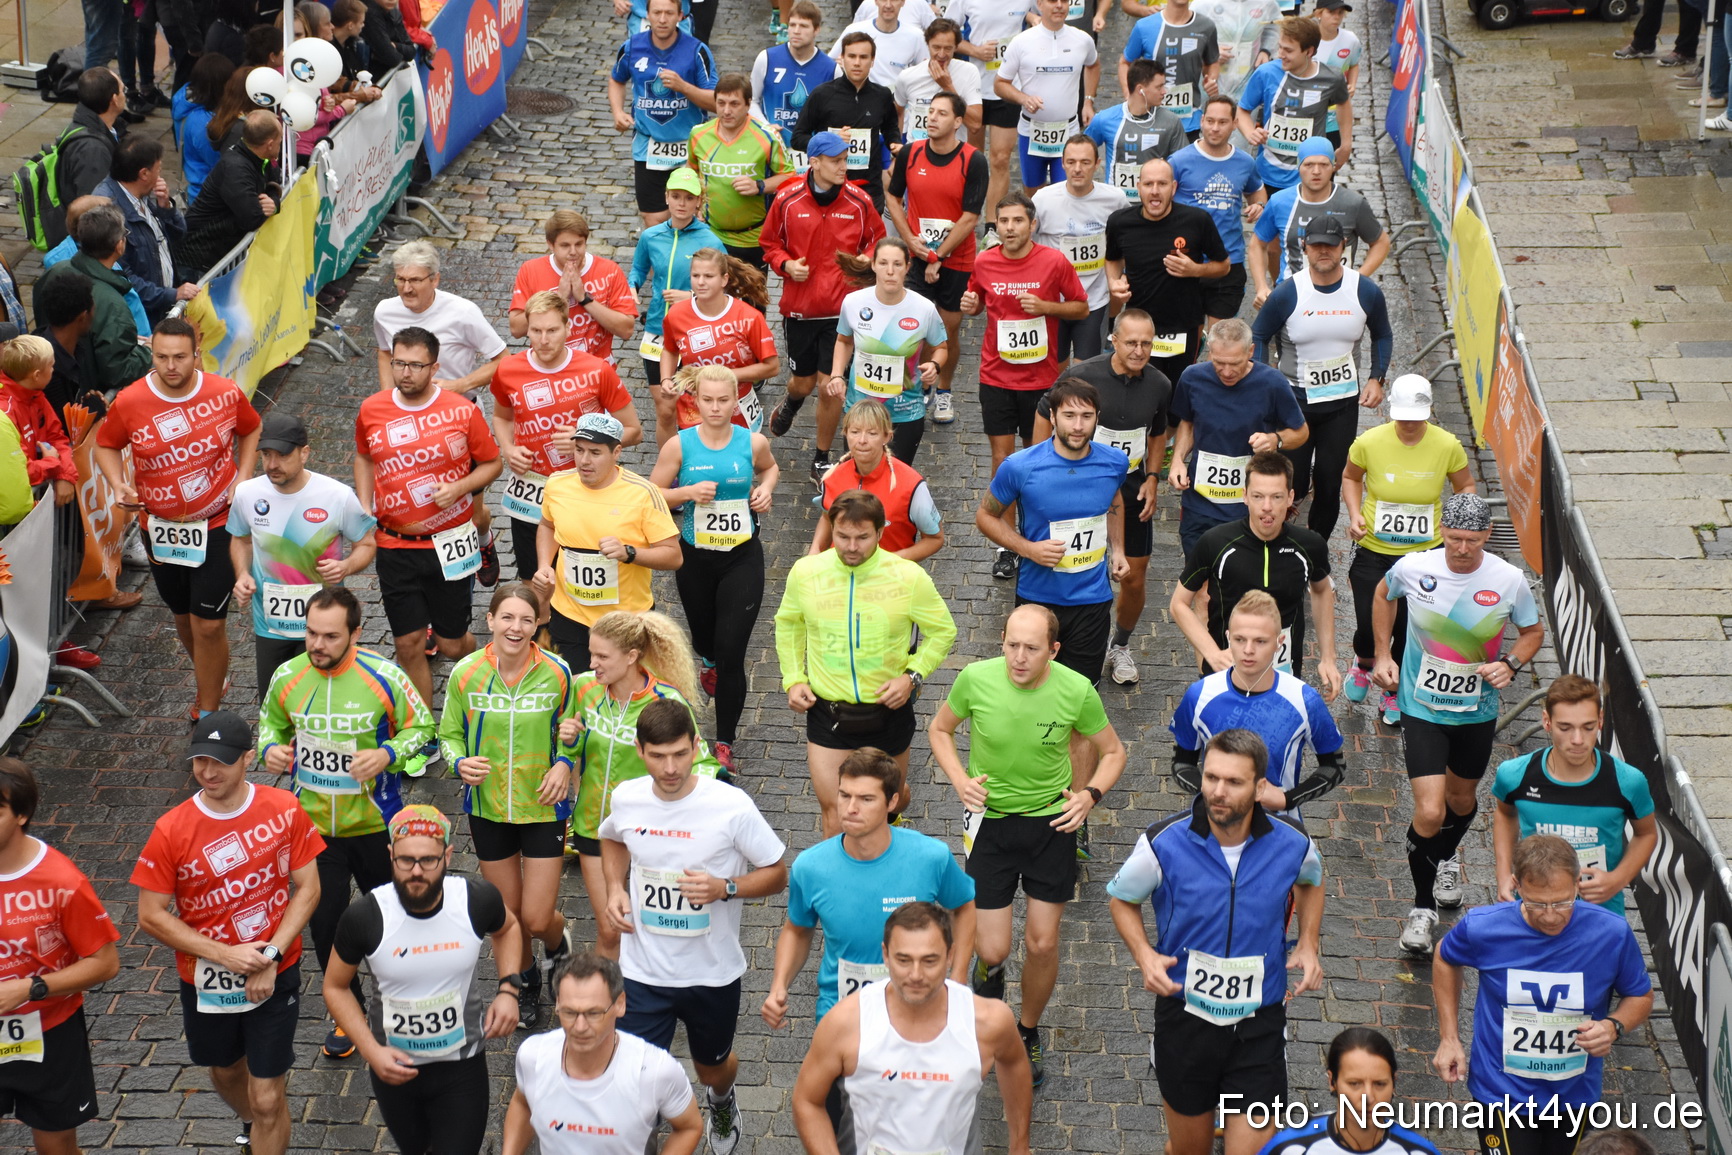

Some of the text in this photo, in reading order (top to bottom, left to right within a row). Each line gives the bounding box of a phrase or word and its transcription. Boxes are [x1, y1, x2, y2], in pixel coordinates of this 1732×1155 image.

[464, 15, 500, 77] Hervis
[634, 57, 648, 72] 4
[774, 68, 786, 83] 7
[428, 68, 452, 136] Hervis
[638, 99, 688, 108] FIBALON
[1160, 92, 1189, 105] 210
[774, 110, 799, 120] FIBA
[1034, 129, 1066, 144] 2597
[1272, 125, 1308, 142] 2138
[652, 142, 686, 157] 2495
[700, 161, 754, 176] BOCK
[1120, 174, 1140, 187] 21
[1070, 244, 1099, 262] 183
[1008, 330, 1039, 348] 340
[1010, 350, 1038, 359] Matthias
[1152, 343, 1173, 352] homas
[864, 363, 892, 382] 341
[1310, 364, 1352, 387] 3055
[869, 383, 884, 392] Nora
[156, 410, 181, 423] raumbox
[195, 414, 224, 430] schenken
[162, 451, 218, 476] wohnen outdoor
[420, 460, 446, 472] outdoor
[1207, 466, 1240, 486] 258
[508, 476, 544, 505] 2620
[1209, 488, 1236, 498] Herbert
[191, 493, 228, 520] raumbox
[511, 501, 530, 514] Oliver
[306, 511, 325, 519] Hervis
[706, 513, 741, 531] 256
[1381, 514, 1428, 534] 2670
[154, 526, 202, 547] 2630
[710, 536, 736, 545] Brigitte
[1070, 530, 1094, 551] 47
[1391, 536, 1415, 544] Nicole
[172, 549, 188, 558] Andi
[443, 531, 479, 562] 2615
[462, 560, 475, 570] Jens
[1073, 555, 1092, 566] Peter
[572, 565, 606, 587] 103
[574, 588, 603, 598] Michael
[1477, 594, 1498, 602] Hervis
[278, 621, 306, 630] Matthia
[1424, 668, 1477, 694] 2028
[469, 693, 557, 712] BOCK
[1430, 695, 1464, 706] Thomas
[292, 713, 374, 733] BOCK
[586, 708, 636, 745] BOC
[301, 748, 353, 772] 2836
[312, 775, 340, 786] Darius
[650, 830, 694, 839] KLEBL
[1536, 823, 1598, 837] HUBER
[206, 834, 236, 854] raumbox
[253, 836, 287, 859] schenken
[644, 884, 703, 910] 207
[234, 905, 265, 922] raumbox
[658, 915, 688, 929] Sergej
[412, 942, 464, 954] KLEBL
[1222, 959, 1258, 970] BOCK
[1193, 968, 1254, 999] 2281
[1200, 1001, 1244, 1016] Bernhard
[392, 1007, 458, 1036] 2539
[1543, 1015, 1584, 1025] BOCK
[407, 1038, 448, 1049] Thomas
[1513, 1027, 1582, 1054] 2442
[1526, 1058, 1566, 1071] Johann
[901, 1072, 953, 1082] KLEBL
[567, 1124, 619, 1136] KLEBL
